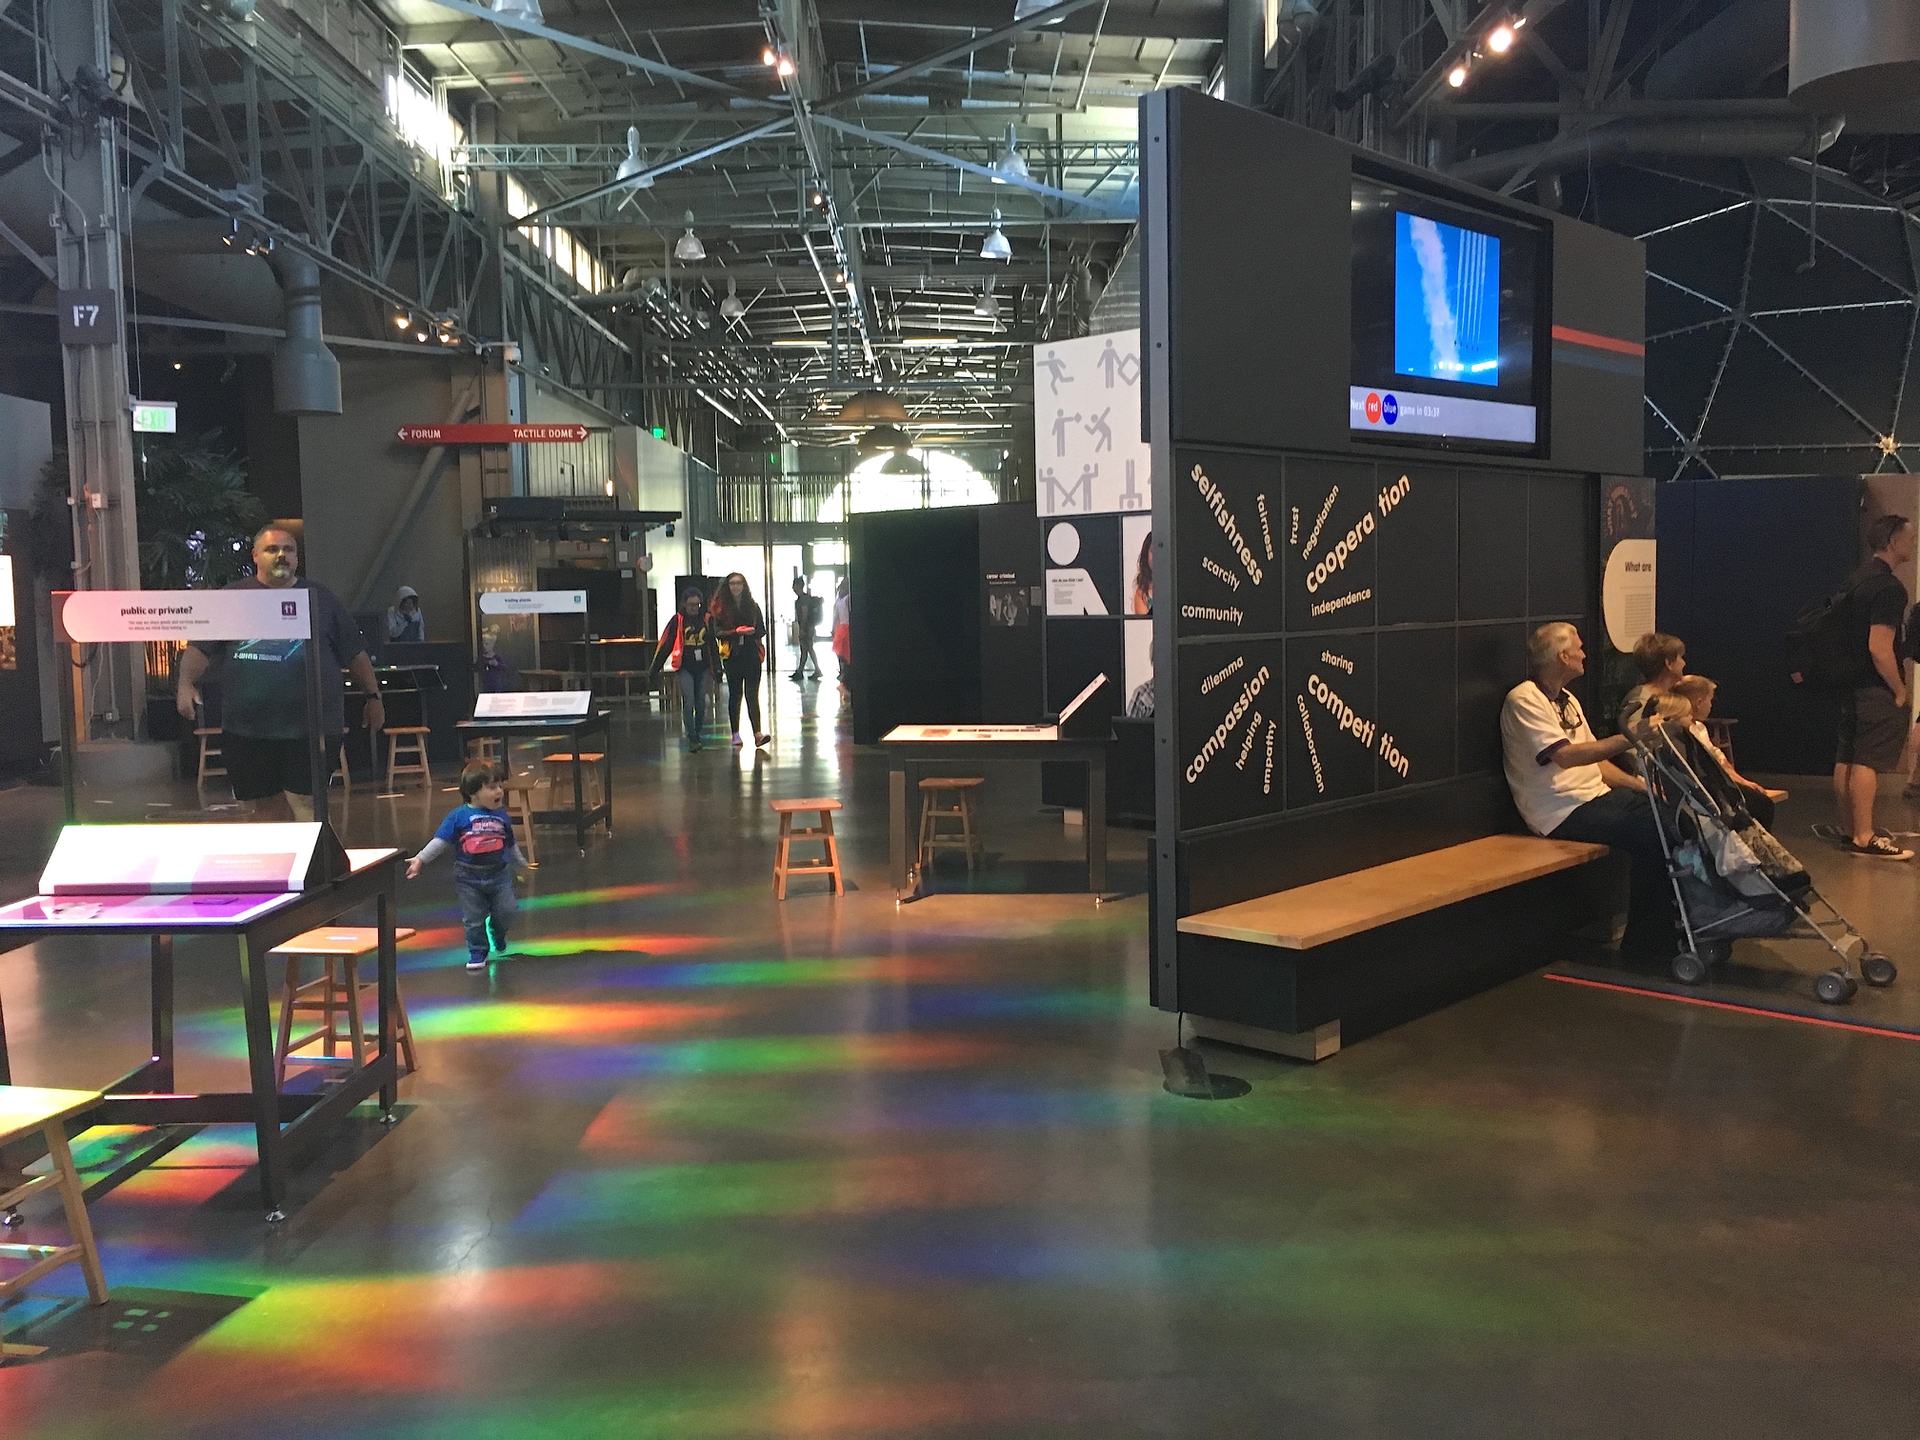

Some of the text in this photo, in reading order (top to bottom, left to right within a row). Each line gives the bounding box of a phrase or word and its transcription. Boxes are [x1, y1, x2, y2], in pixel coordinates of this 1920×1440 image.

[73, 305, 99, 327] F7
[141, 409, 168, 429] EXIT
[1368, 401, 1378, 412] red
[1384, 402, 1397, 414] blue
[1400, 406, 1415, 417] game
[1417, 405, 1423, 415] in
[411, 429, 441, 439] FORUM
[513, 428, 573, 438] TACTILE DOME
[1192, 464, 1262, 585] selfishness
[1257, 494, 1273, 560] fairness
[1290, 507, 1299, 544] trust
[1303, 485, 1338, 560] negotiation
[1202, 557, 1240, 591] scarcity
[1625, 561, 1652, 572] What are
[121, 606, 146, 617] public
[159, 605, 193, 616] private?
[1182, 605, 1243, 626] community
[1312, 589, 1370, 616] independence
[1202, 657, 1243, 694] dilemma
[1322, 651, 1353, 674] sharing
[1187, 666, 1269, 783] compassion
[1236, 711, 1261, 770] helping
[1298, 695, 1324, 792] collaboration
[1264, 720, 1276, 794] empathy
